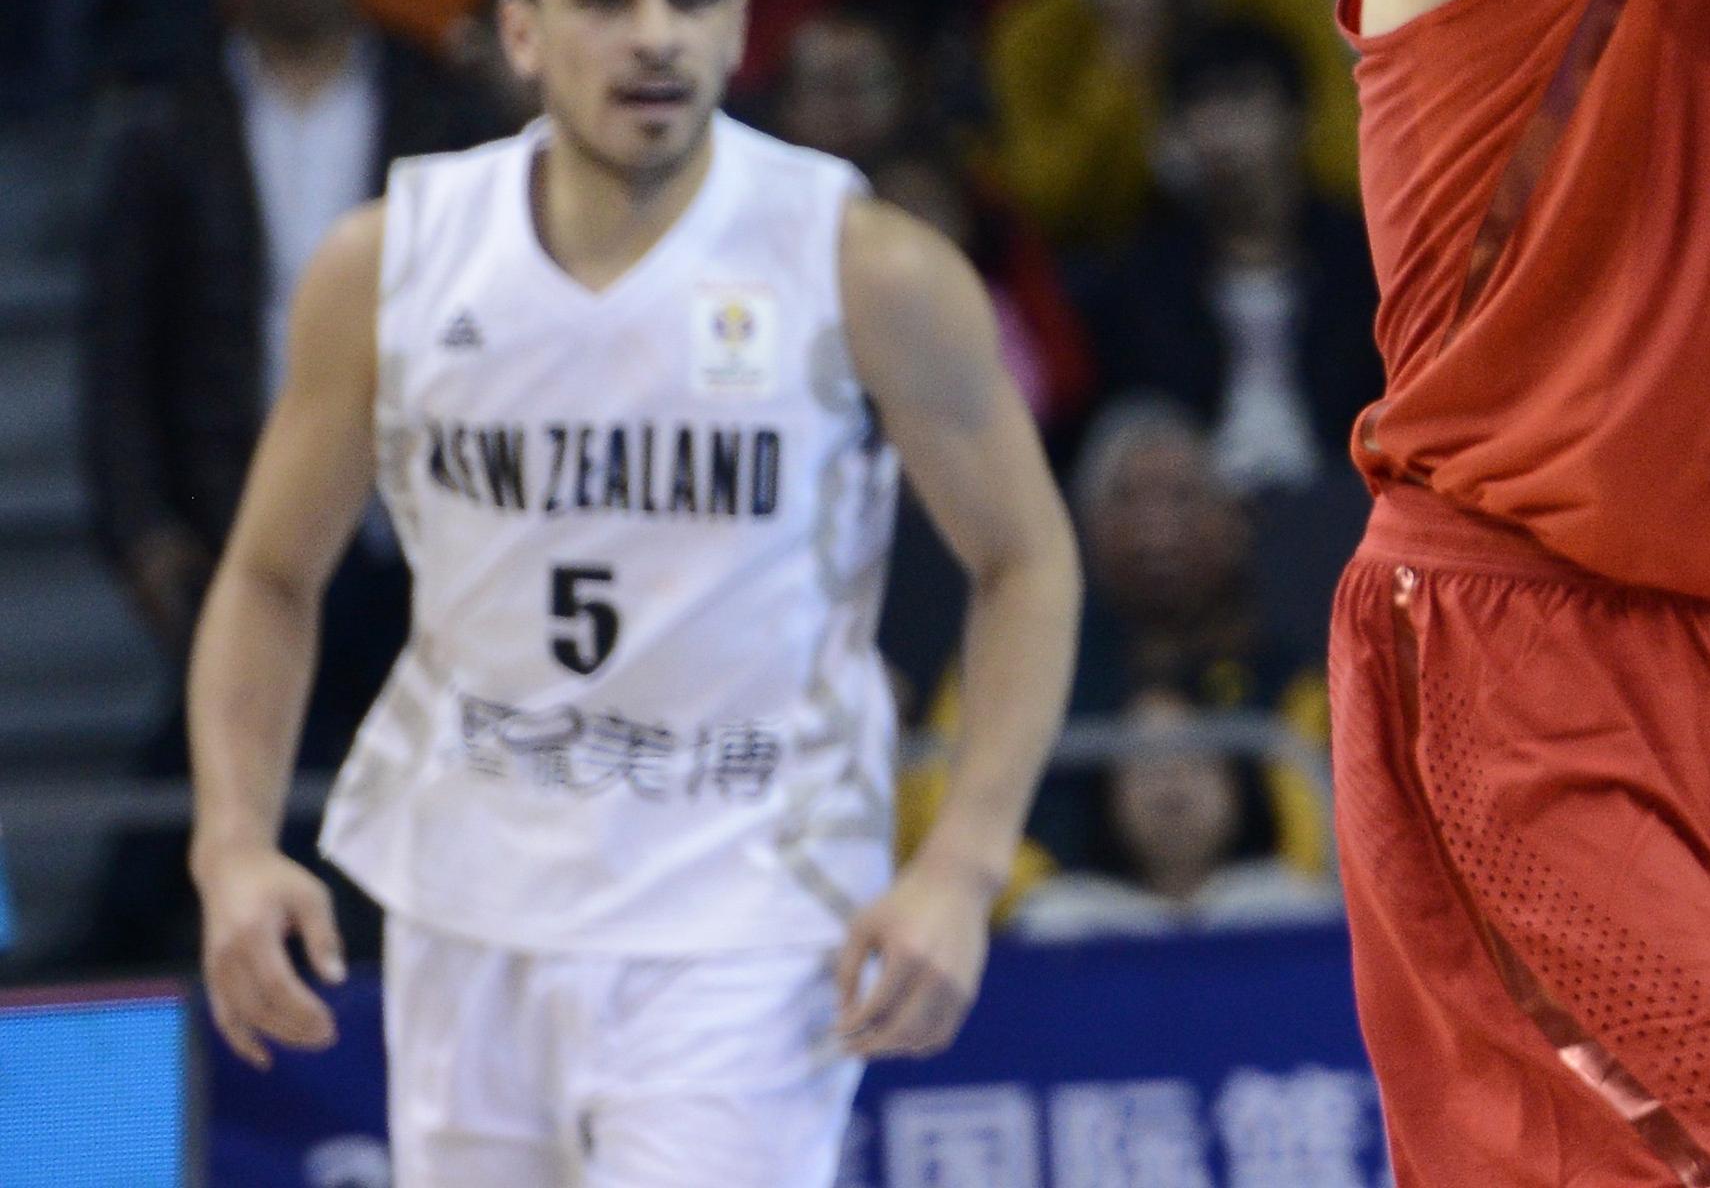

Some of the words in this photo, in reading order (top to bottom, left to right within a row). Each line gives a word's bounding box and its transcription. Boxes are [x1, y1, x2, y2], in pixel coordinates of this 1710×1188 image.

[425, 422, 526, 511] NEW
[546, 427, 781, 516] ZEALAND
[550, 557, 619, 676] 5
